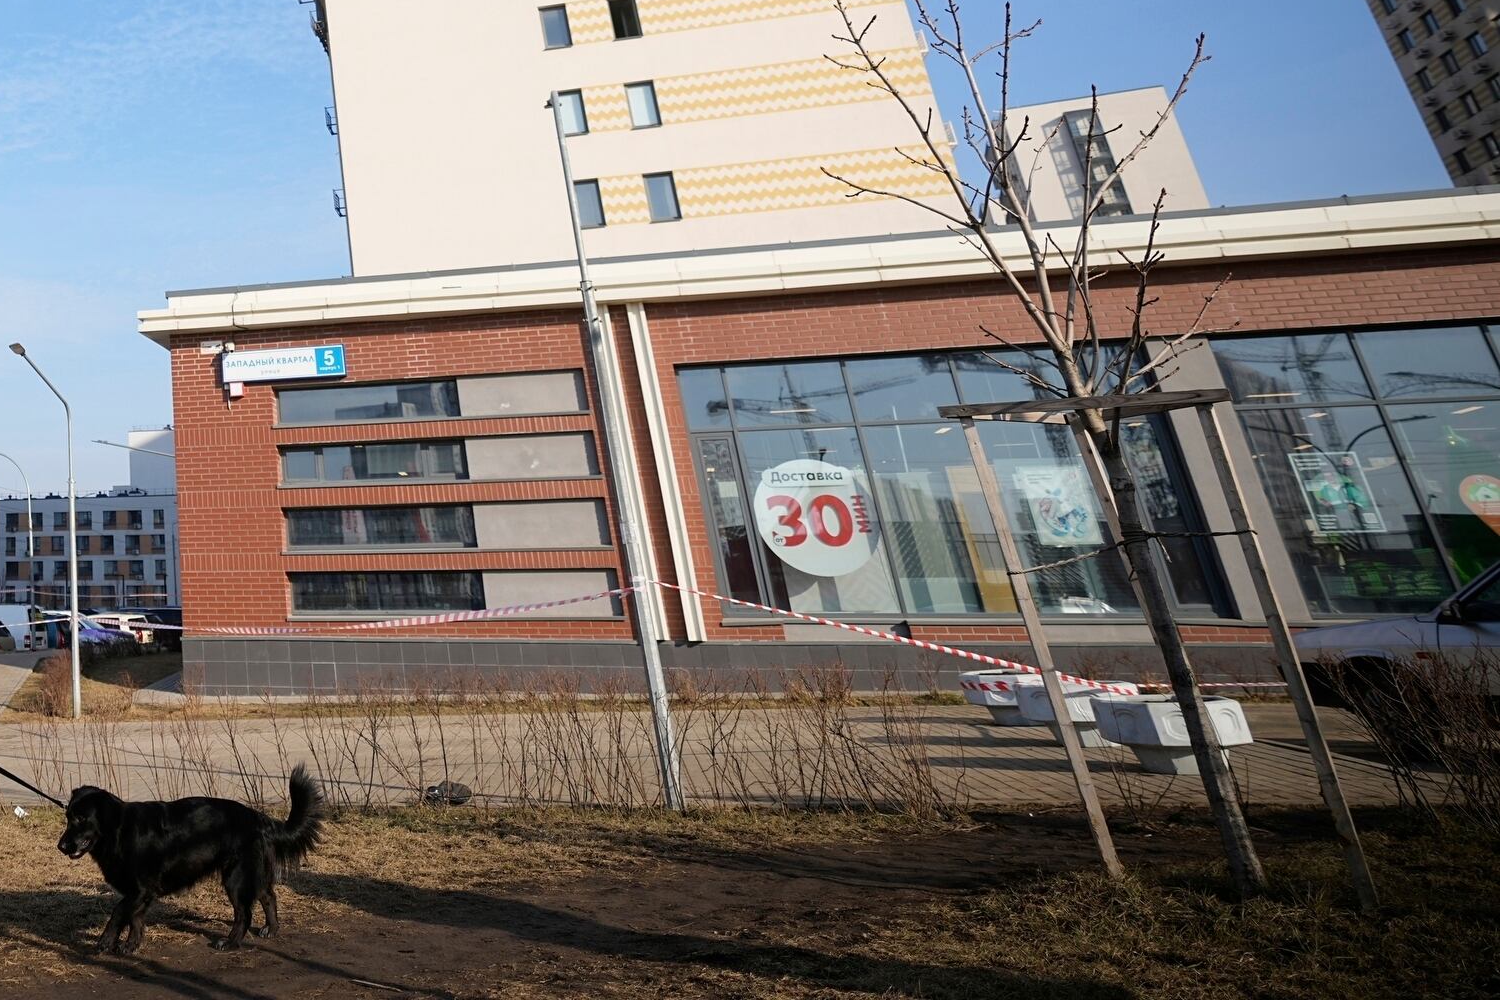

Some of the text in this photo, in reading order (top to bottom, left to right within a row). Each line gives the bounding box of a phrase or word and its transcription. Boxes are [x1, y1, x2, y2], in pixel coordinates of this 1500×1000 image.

[226, 355, 315, 368] ЗАПАДНЫЙ КВАРТАЛ
[323, 350, 335, 366] 5
[771, 471, 843, 484] Доставка
[766, 494, 853, 547] 30
